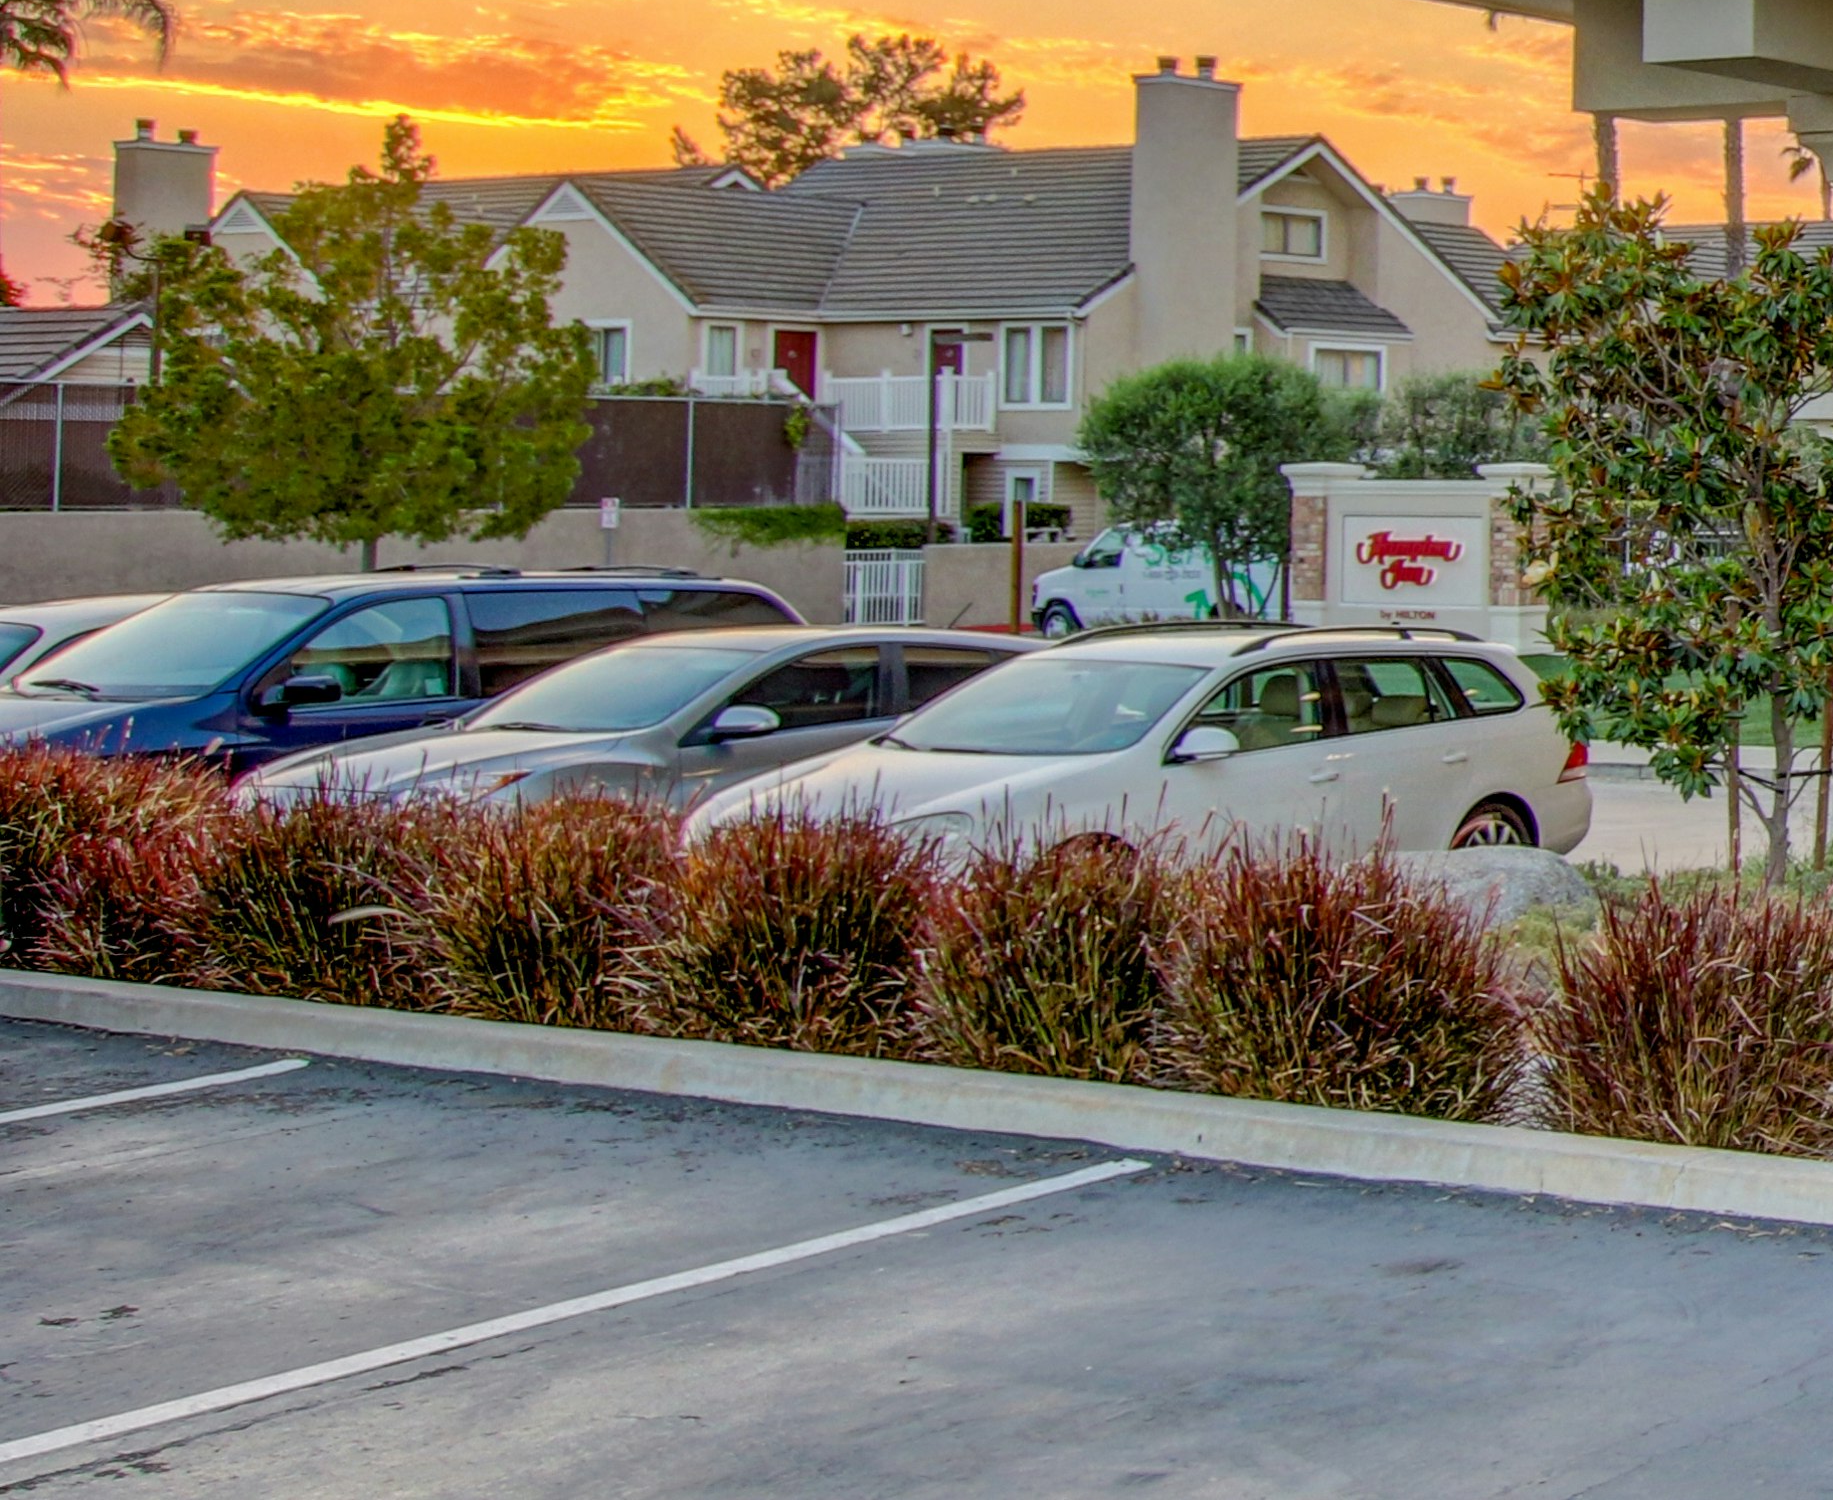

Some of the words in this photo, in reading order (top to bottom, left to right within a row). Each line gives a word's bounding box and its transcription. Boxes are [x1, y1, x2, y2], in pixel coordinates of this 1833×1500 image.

[1356, 530, 1462, 565] Hampton
[1380, 558, 1435, 590] Inn
[1396, 610, 1436, 620] HILTON
